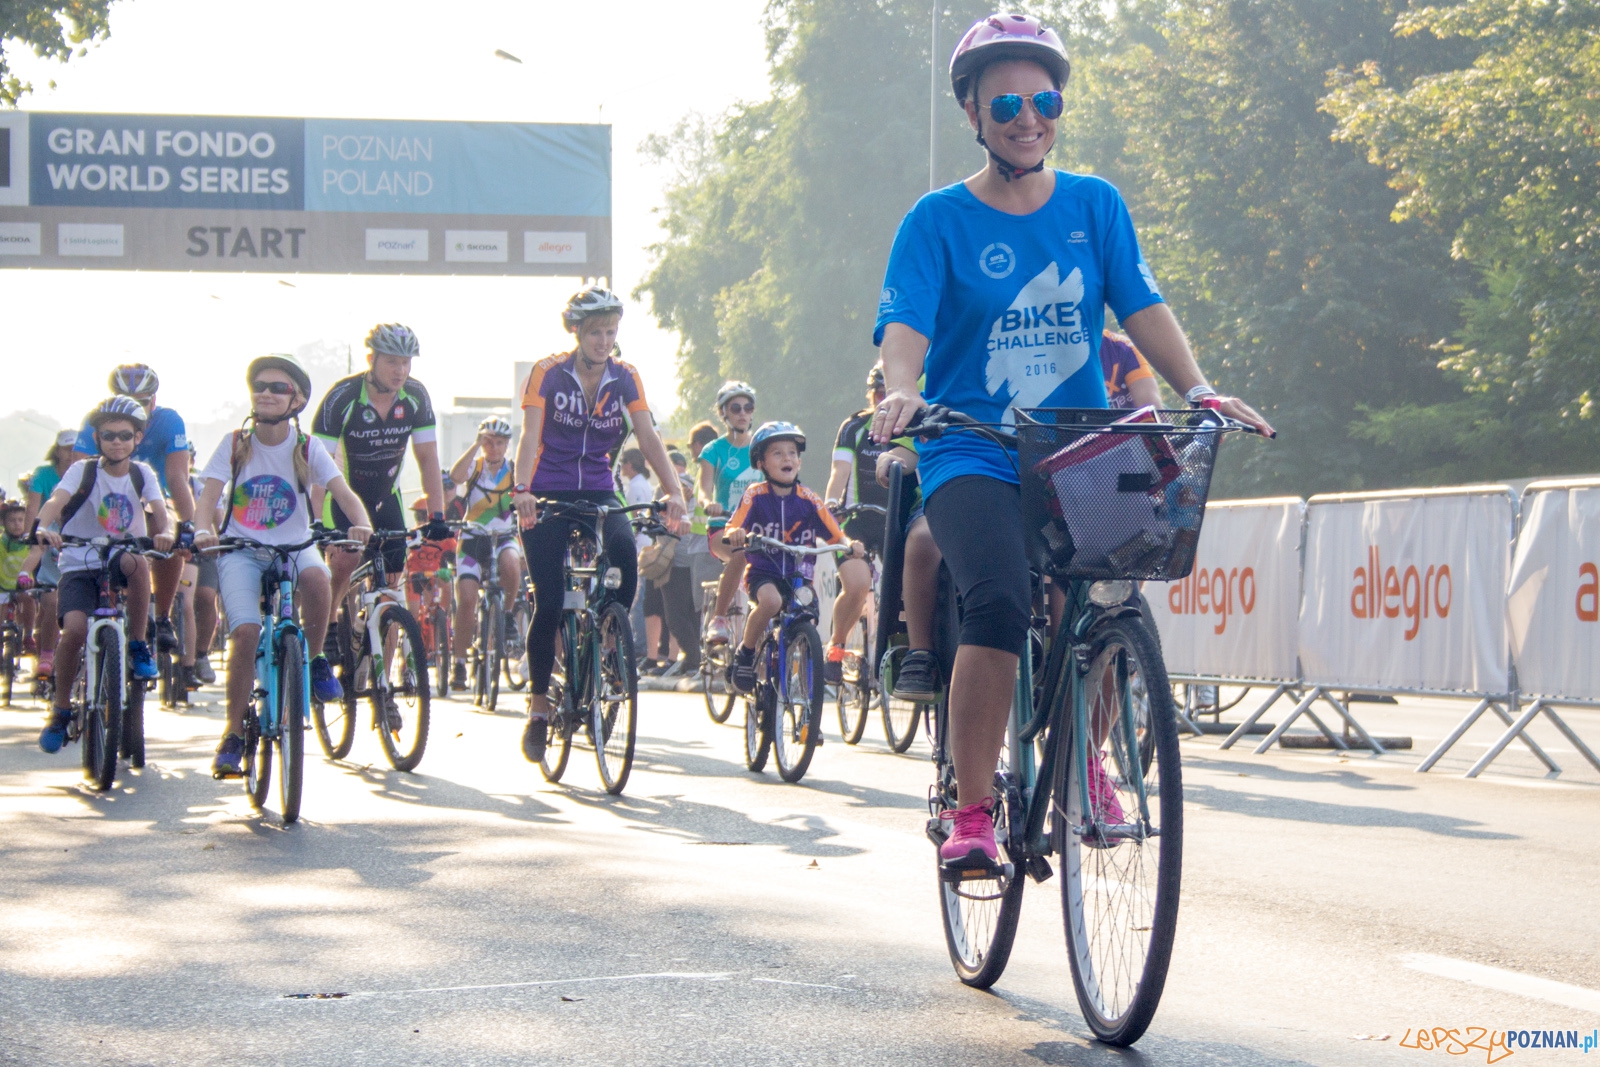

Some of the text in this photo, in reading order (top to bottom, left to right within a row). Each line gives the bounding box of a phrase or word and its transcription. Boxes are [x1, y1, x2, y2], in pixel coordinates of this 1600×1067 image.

[48, 127, 275, 158] GRAN FONDO
[322, 135, 432, 162] POZNAN
[47, 164, 289, 194] WORLD SERIES
[322, 169, 433, 196] POLAND
[185, 226, 306, 258] START
[538, 242, 572, 254] allegro
[1000, 301, 1076, 333] BIKE
[985, 327, 1090, 352] CHALLENGE
[1025, 362, 1056, 377] 2016
[553, 410, 623, 429] Bike Team
[349, 427, 379, 438] AUTO
[368, 438, 399, 447] TEAM
[249, 497, 289, 510] COLOR
[252, 484, 274, 498] THE
[245, 508, 273, 523] RUN
[1168, 550, 1256, 636] allegro
[1350, 545, 1452, 641] allegro
